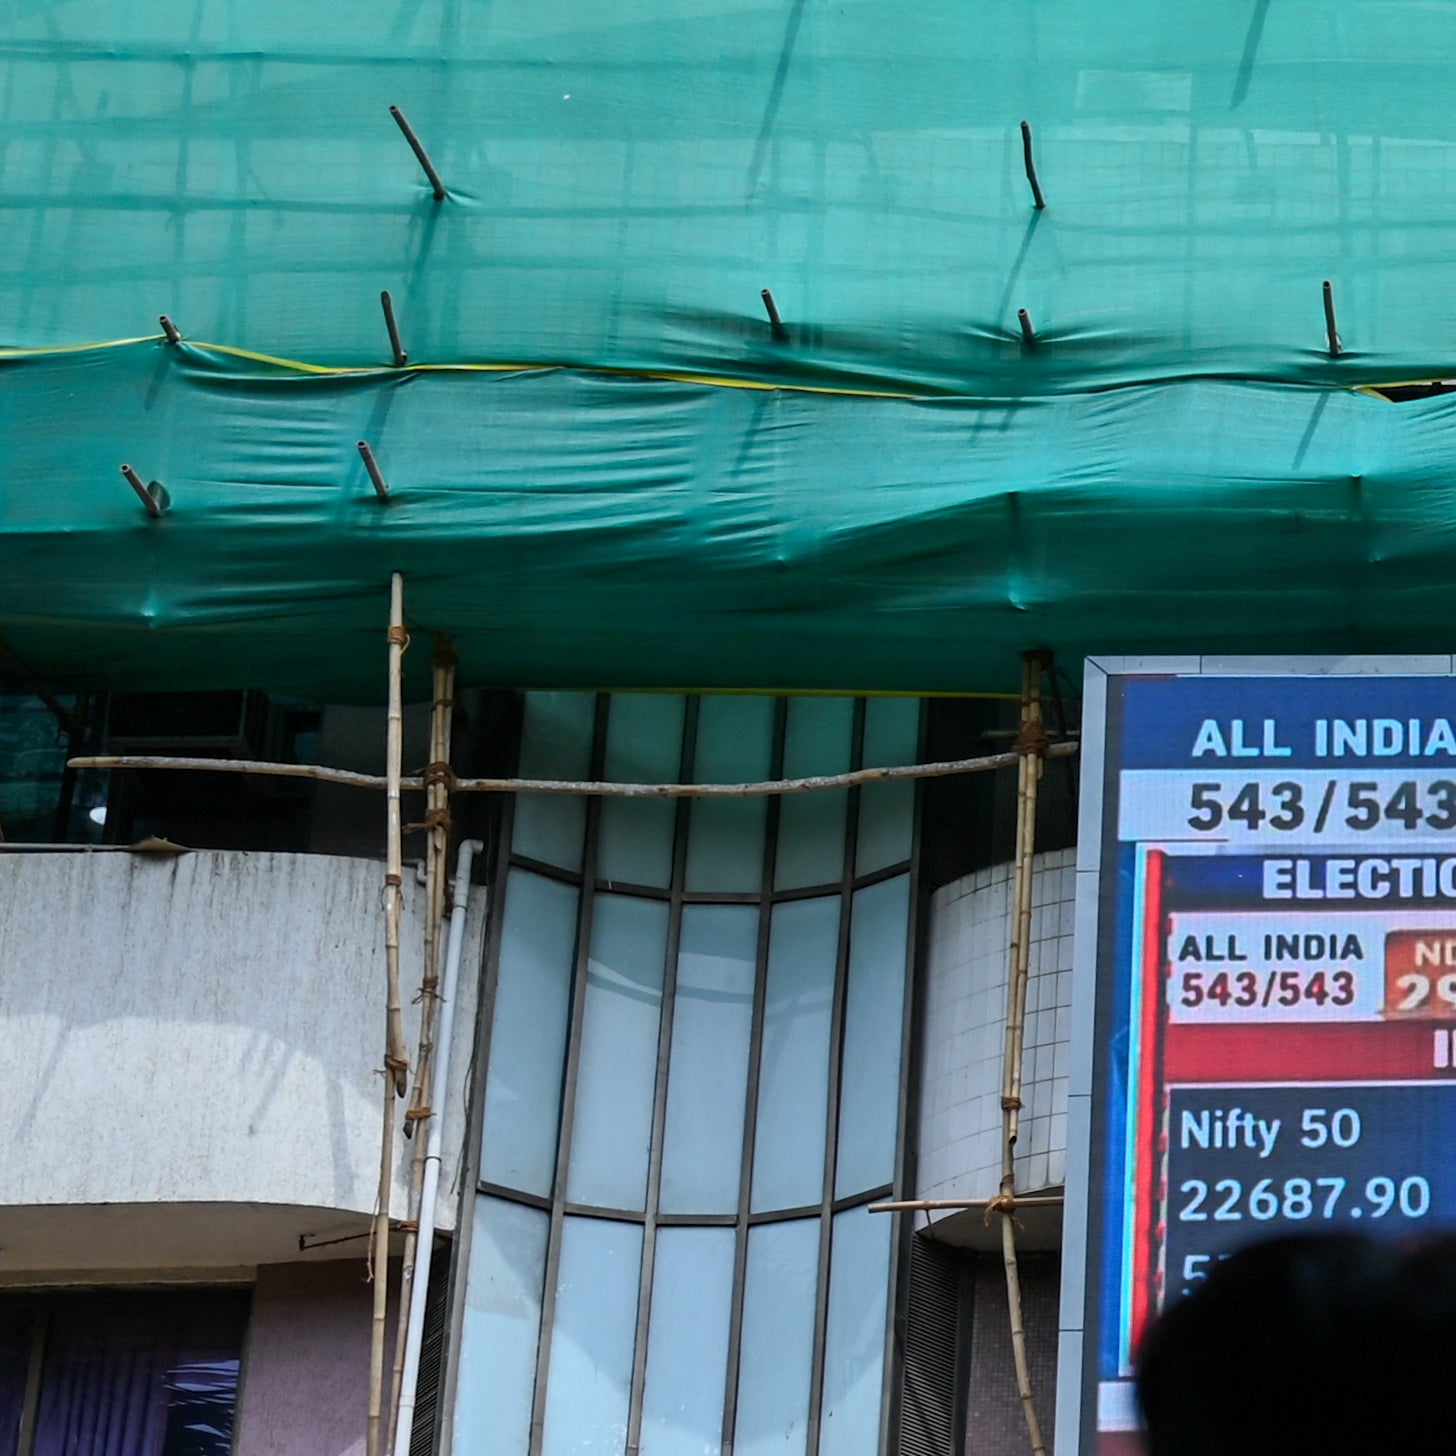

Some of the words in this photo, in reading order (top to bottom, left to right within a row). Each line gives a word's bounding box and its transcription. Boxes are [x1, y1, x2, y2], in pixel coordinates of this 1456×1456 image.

[1191, 719, 1292, 757] ALL
[1178, 934, 1248, 962] ALL
[1263, 933, 1364, 960] INDIA
[1181, 969, 1356, 1009] 543/543
[1180, 1107, 1282, 1159] Nifty
[1301, 1107, 1361, 1149] 50
[1179, 1175, 1431, 1222] 22687.90
